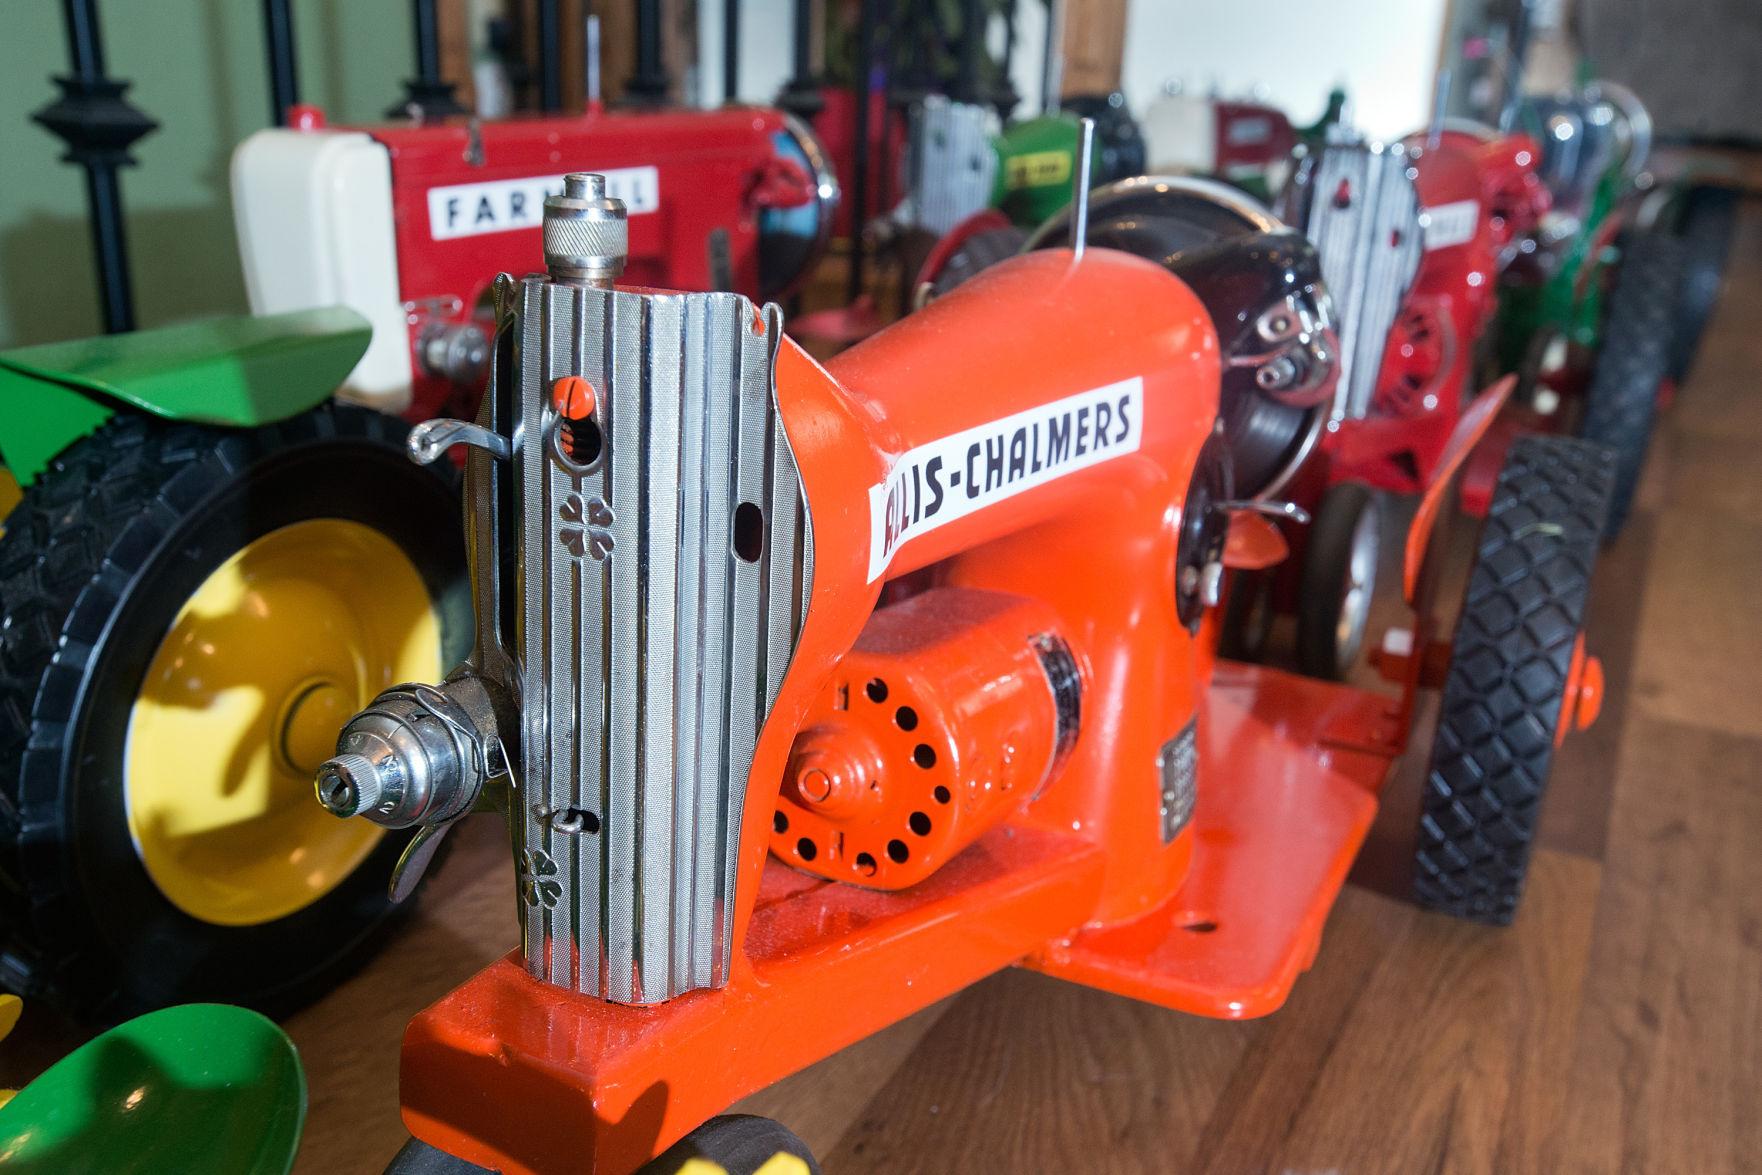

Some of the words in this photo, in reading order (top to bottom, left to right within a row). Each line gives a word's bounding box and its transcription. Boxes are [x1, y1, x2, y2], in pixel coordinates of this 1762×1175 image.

[447, 176, 643, 229] FARL
[882, 394, 1130, 559] ALLIS-CHALMERS
[378, 801, 395, 815] 2
